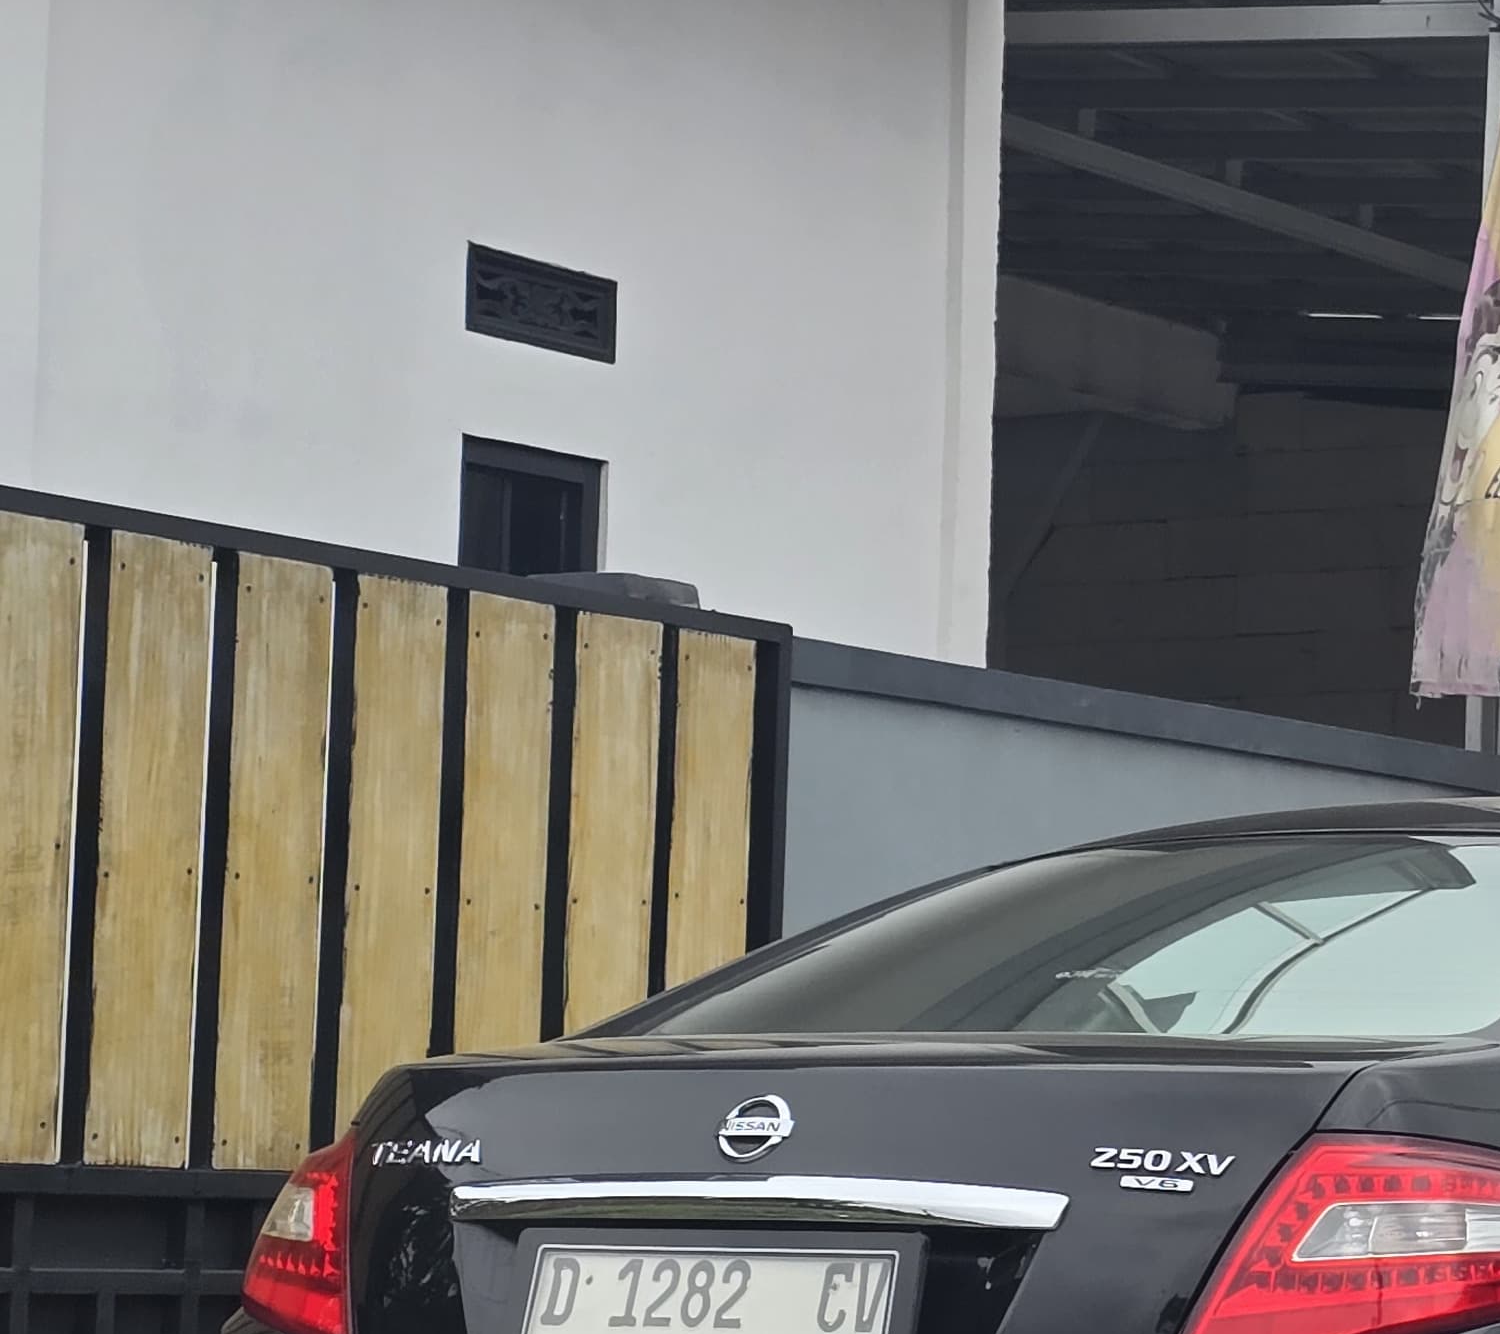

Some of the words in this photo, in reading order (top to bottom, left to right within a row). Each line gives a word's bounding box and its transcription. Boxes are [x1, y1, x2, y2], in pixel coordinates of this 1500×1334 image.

[371, 1139, 481, 1166] TEANA
[1090, 1147, 1172, 1172] 250
[1174, 1151, 1236, 1176] XV
[1135, 1178, 1178, 1189] V6
[540, 1257, 581, 1326] D
[607, 1258, 752, 1329] 1282
[816, 1260, 889, 1333] CV
